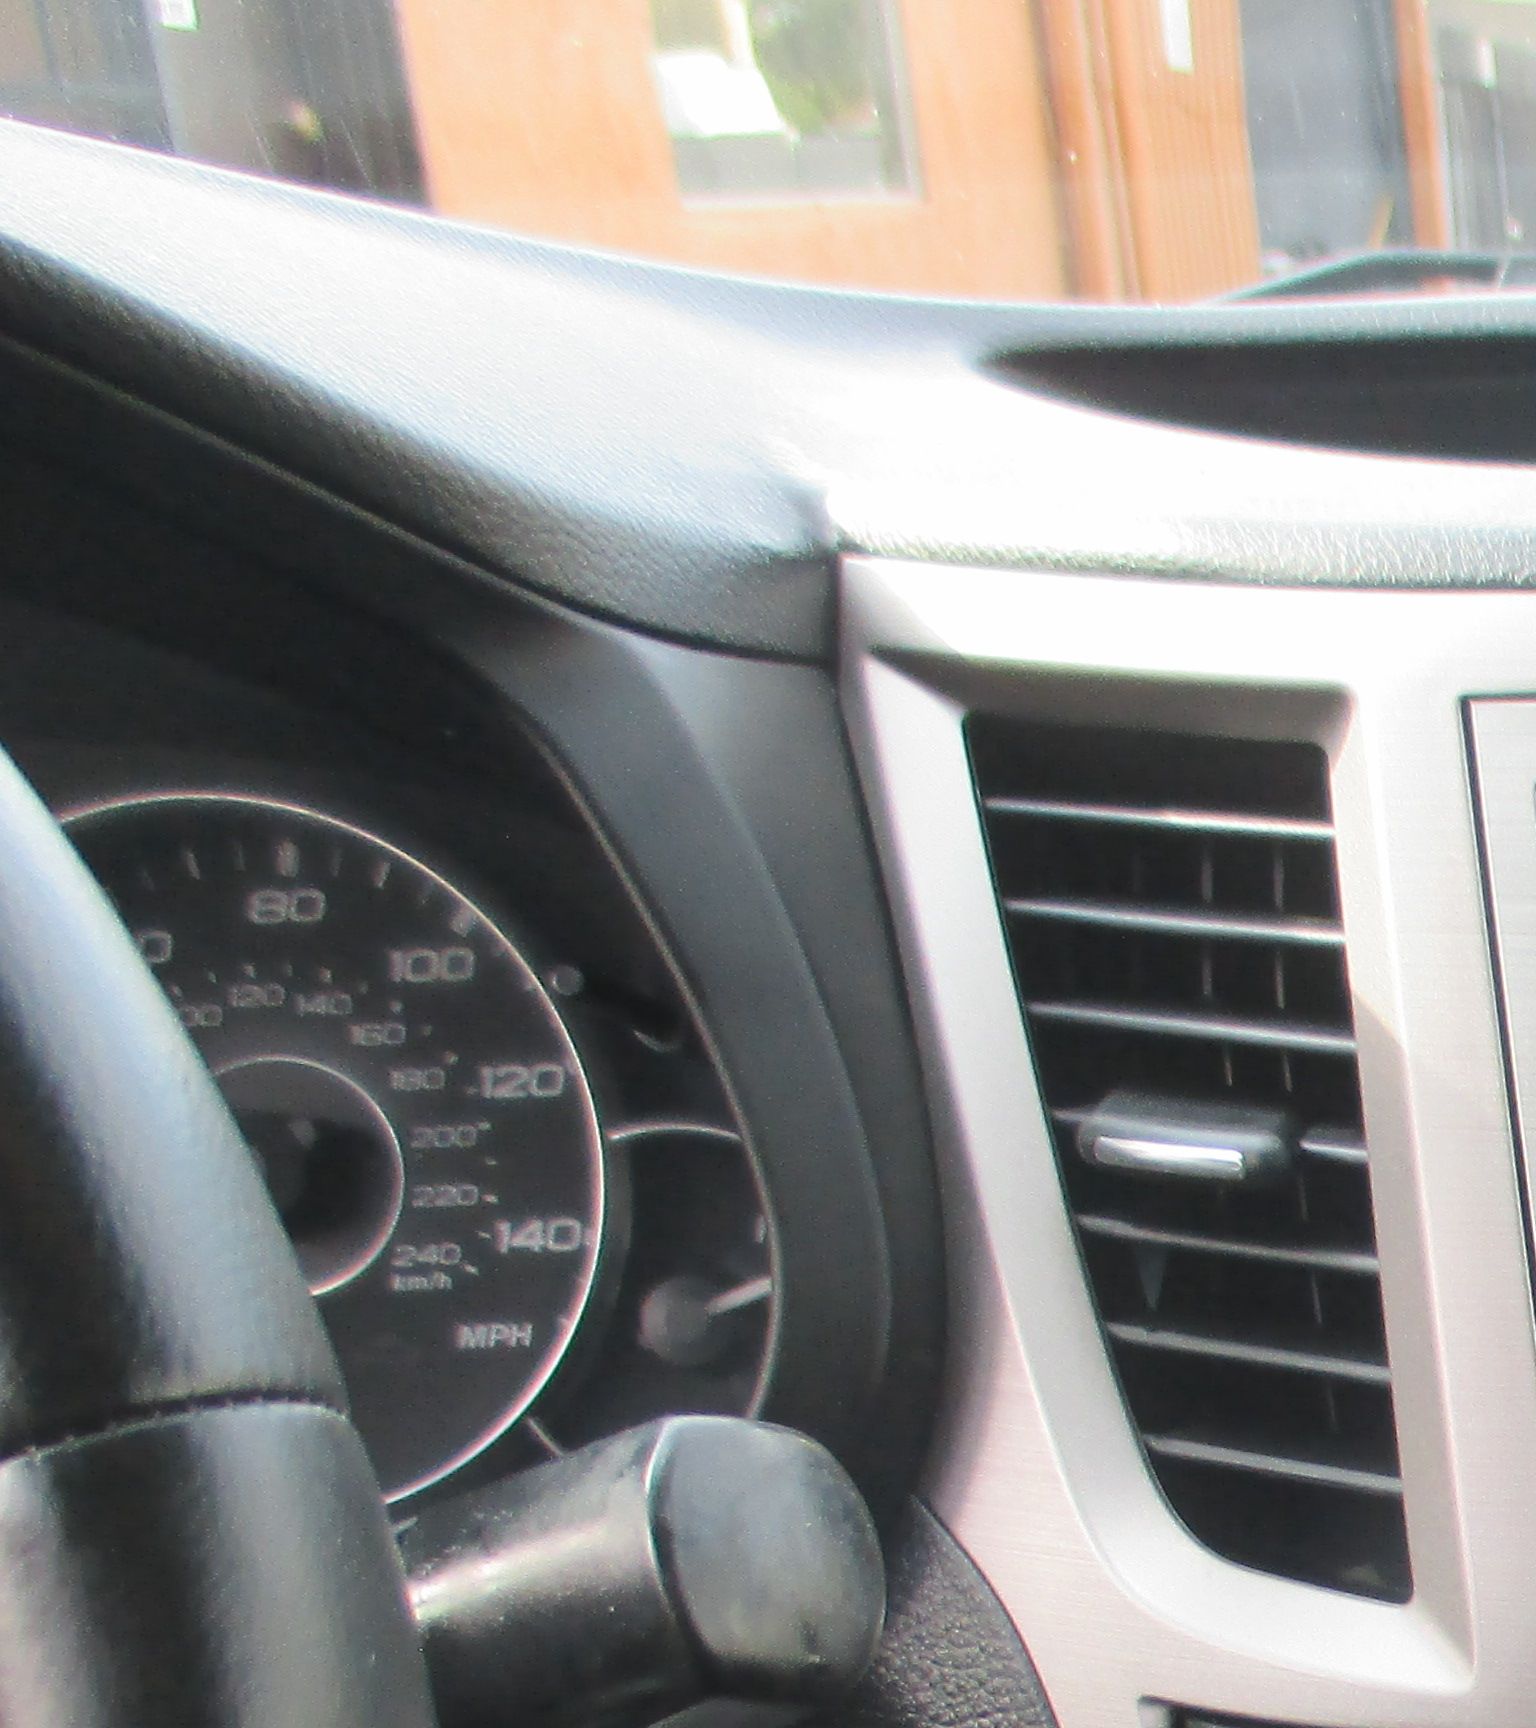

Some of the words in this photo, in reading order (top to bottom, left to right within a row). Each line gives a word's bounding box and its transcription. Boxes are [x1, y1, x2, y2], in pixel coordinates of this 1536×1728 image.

[246, 888, 326, 924] 80
[388, 947, 475, 982] 100
[228, 983, 286, 1008] 120
[295, 993, 353, 1016] 140
[349, 1023, 406, 1046] 160
[390, 1067, 445, 1091] 180
[480, 1064, 564, 1098] 120
[409, 1125, 478, 1148] 200
[411, 1184, 479, 1206] 220
[495, 1217, 582, 1252] 140
[393, 1242, 461, 1267] 240
[390, 1272, 453, 1292] km/h
[456, 1322, 532, 1348] MPH
